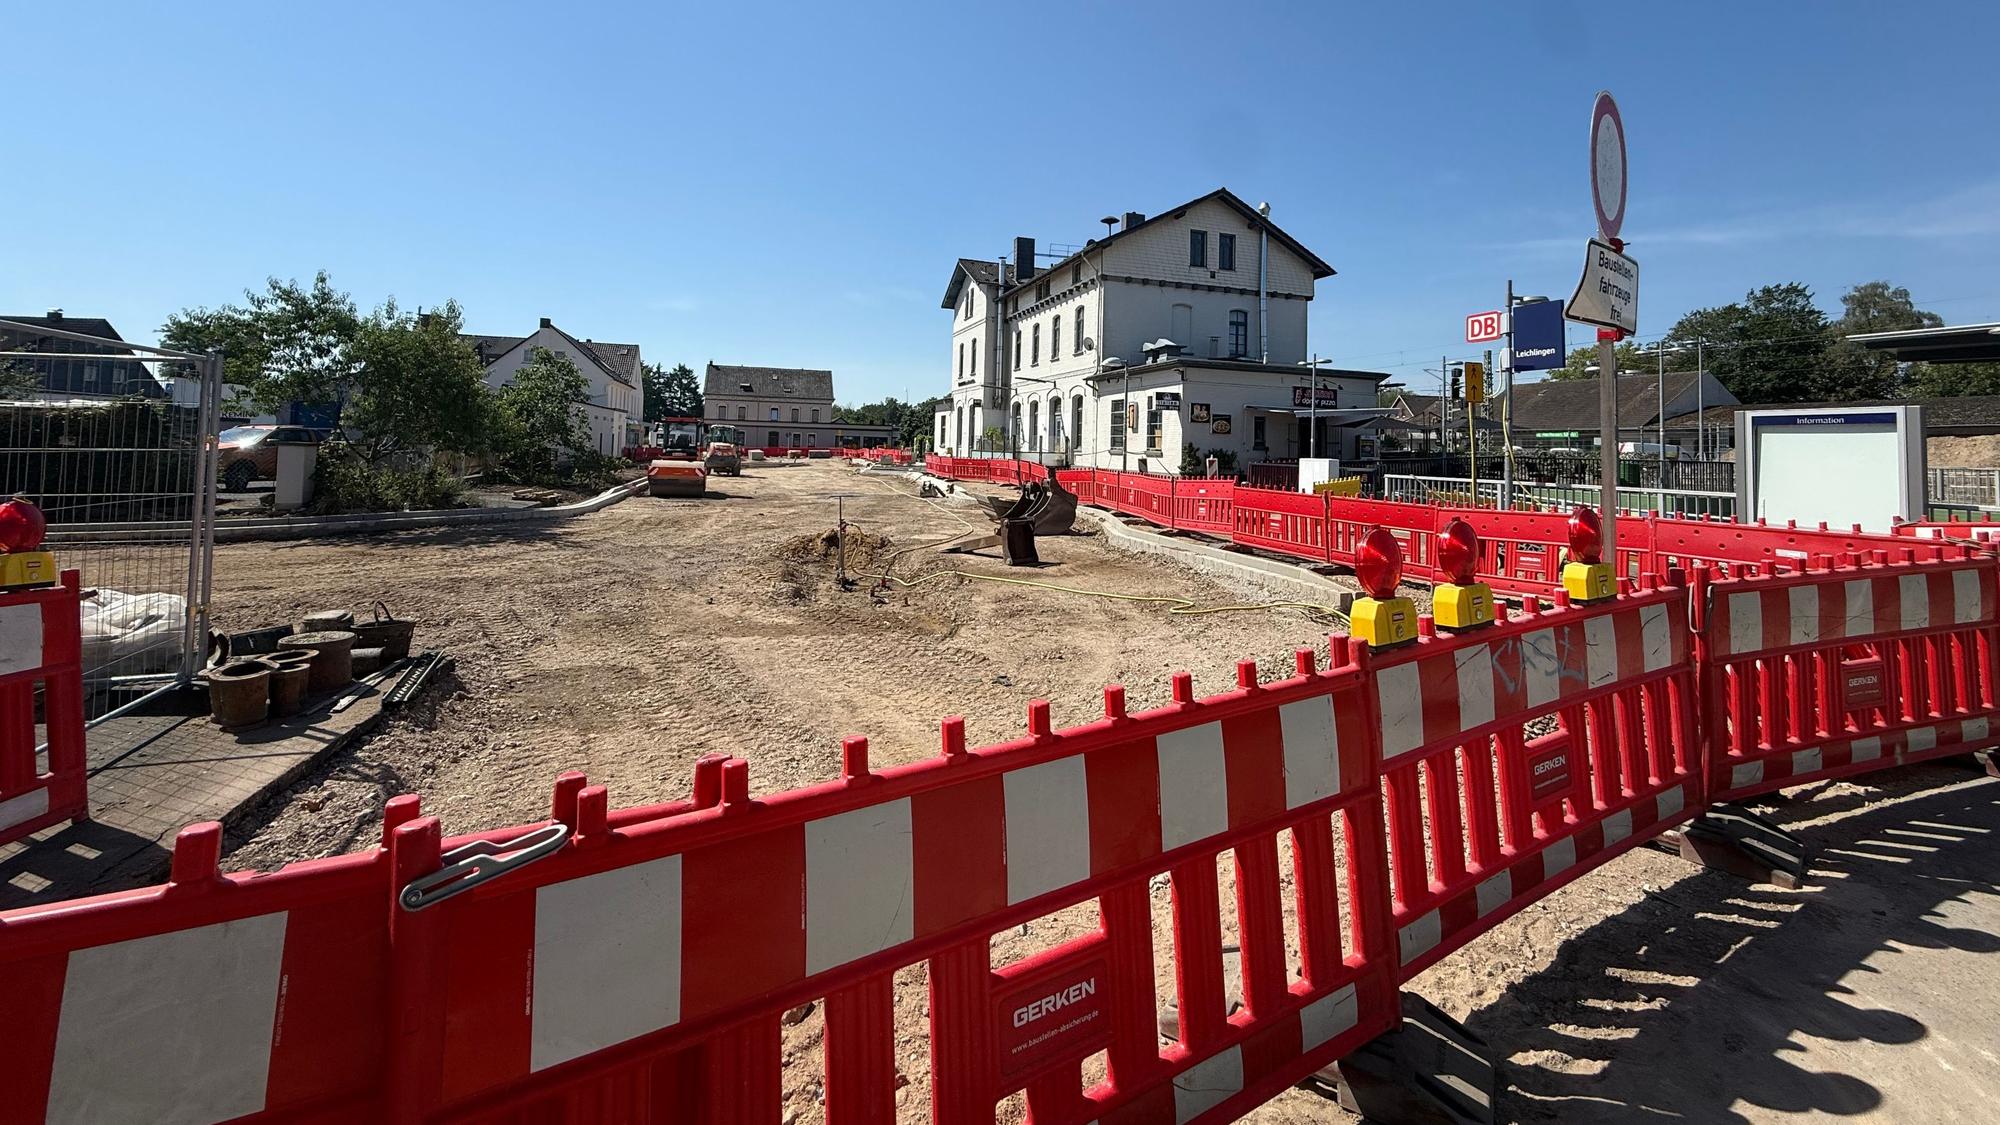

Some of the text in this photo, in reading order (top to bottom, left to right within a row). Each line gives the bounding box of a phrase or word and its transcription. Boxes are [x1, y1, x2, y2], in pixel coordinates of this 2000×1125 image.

[1598, 250, 1634, 280] Baustellen-
[1599, 276, 1631, 306] fahrzeuge
[1609, 304, 1622, 322] frei
[1471, 317, 1496, 338] DB
[1515, 347, 1556, 358] Leichlingen
[1796, 417, 1845, 425] Information
[1848, 675, 1878, 687] GERKEN
[1534, 754, 1566, 776] GERKEN
[1013, 977, 1095, 1028] GERKEN
